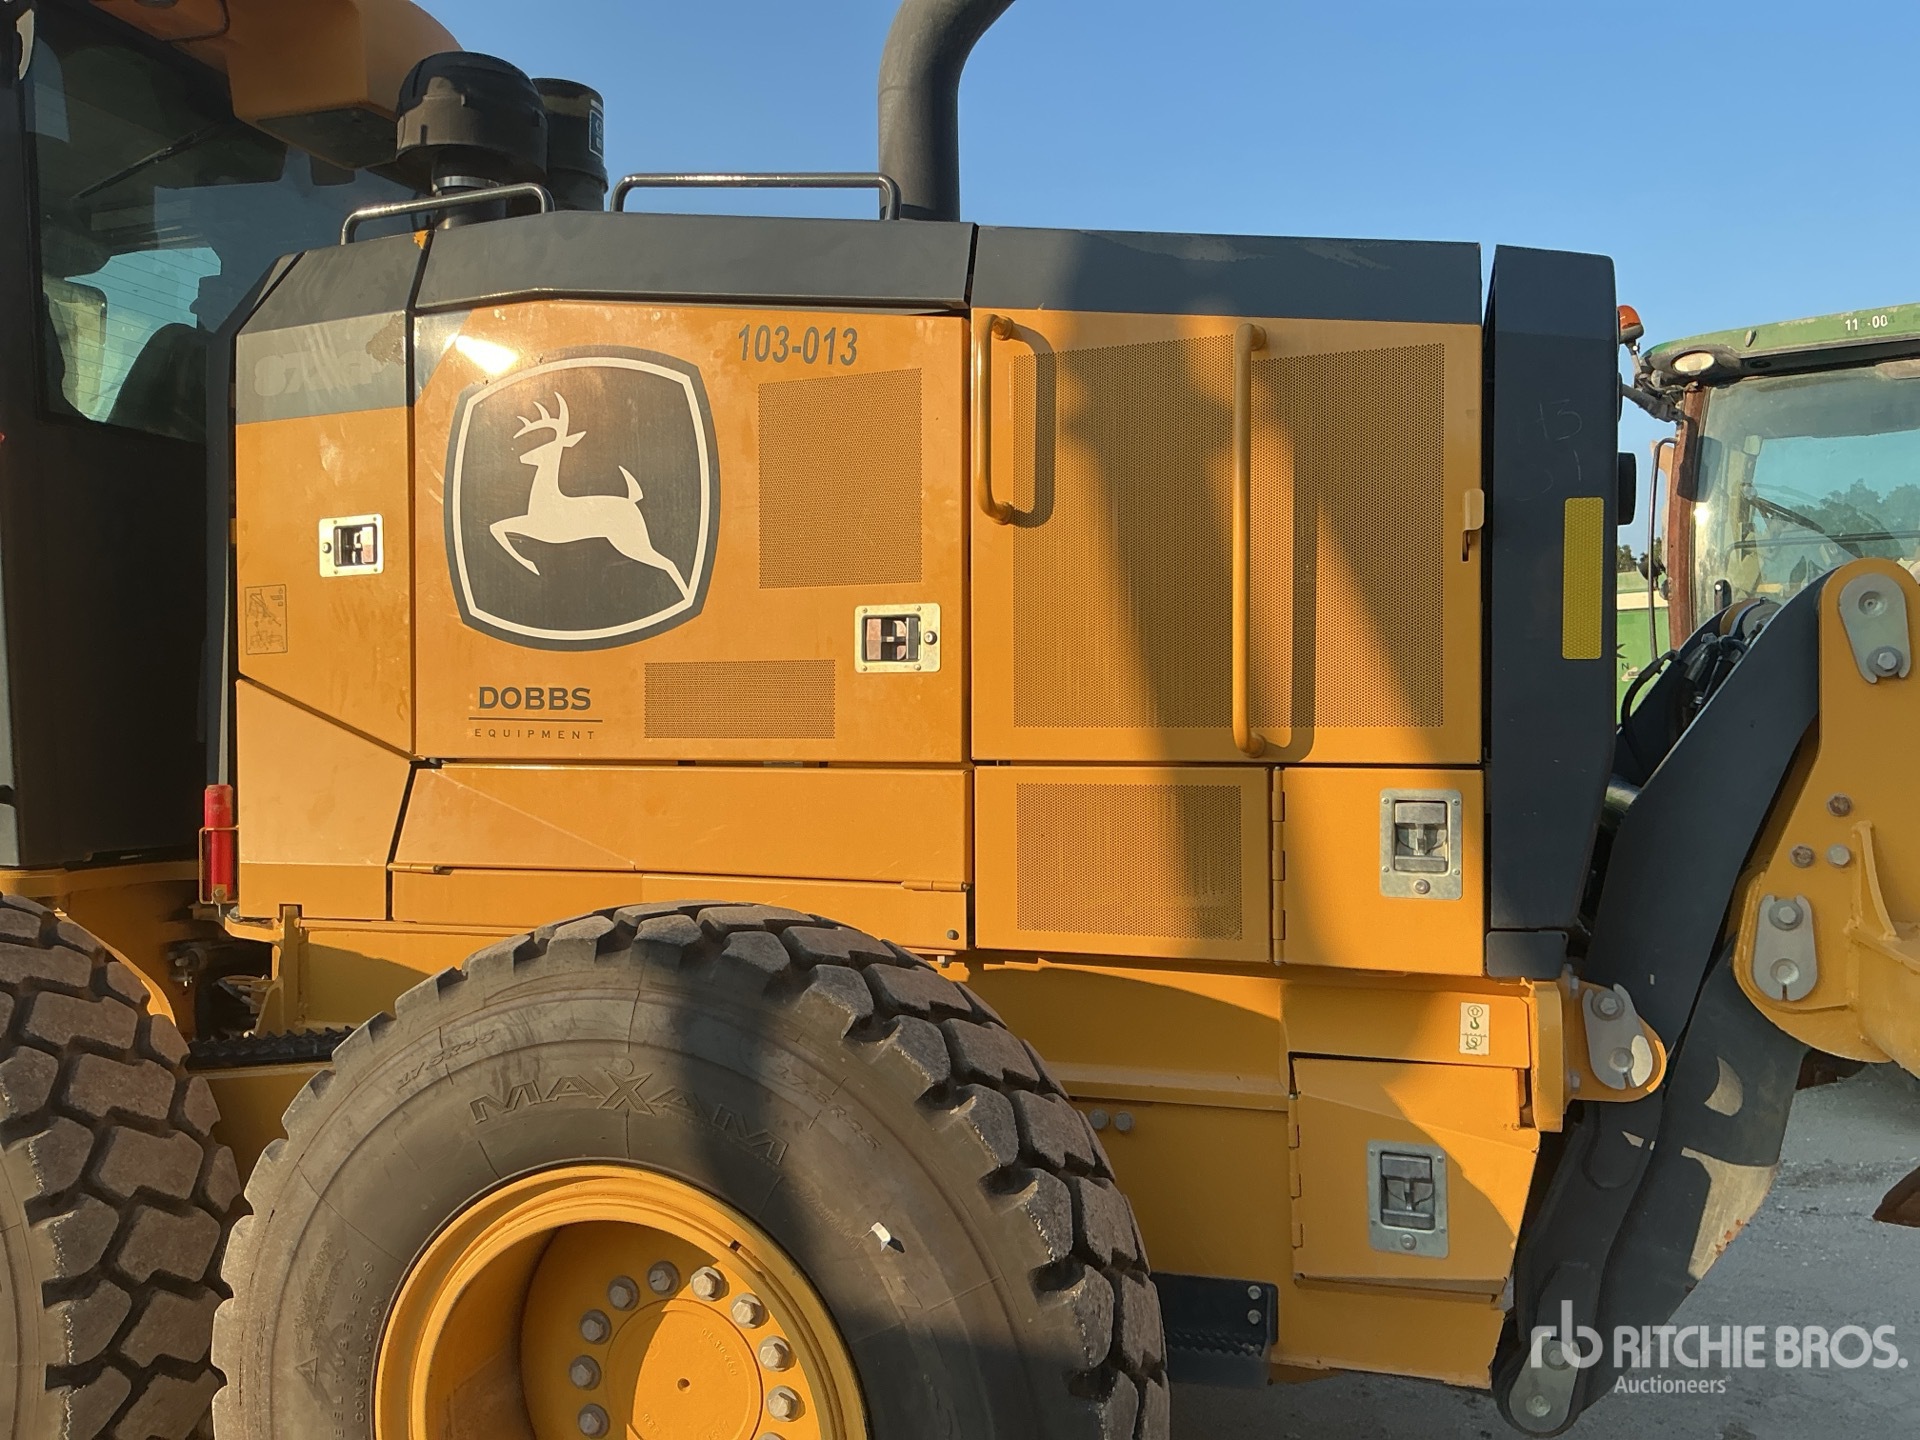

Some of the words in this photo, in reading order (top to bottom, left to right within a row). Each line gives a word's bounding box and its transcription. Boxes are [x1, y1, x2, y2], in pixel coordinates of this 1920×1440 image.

[738, 324, 858, 366] 103-013
[479, 686, 591, 711] DOBBS
[474, 728, 595, 740] EQUIPMENT
[468, 1062, 788, 1166] MAXAM
